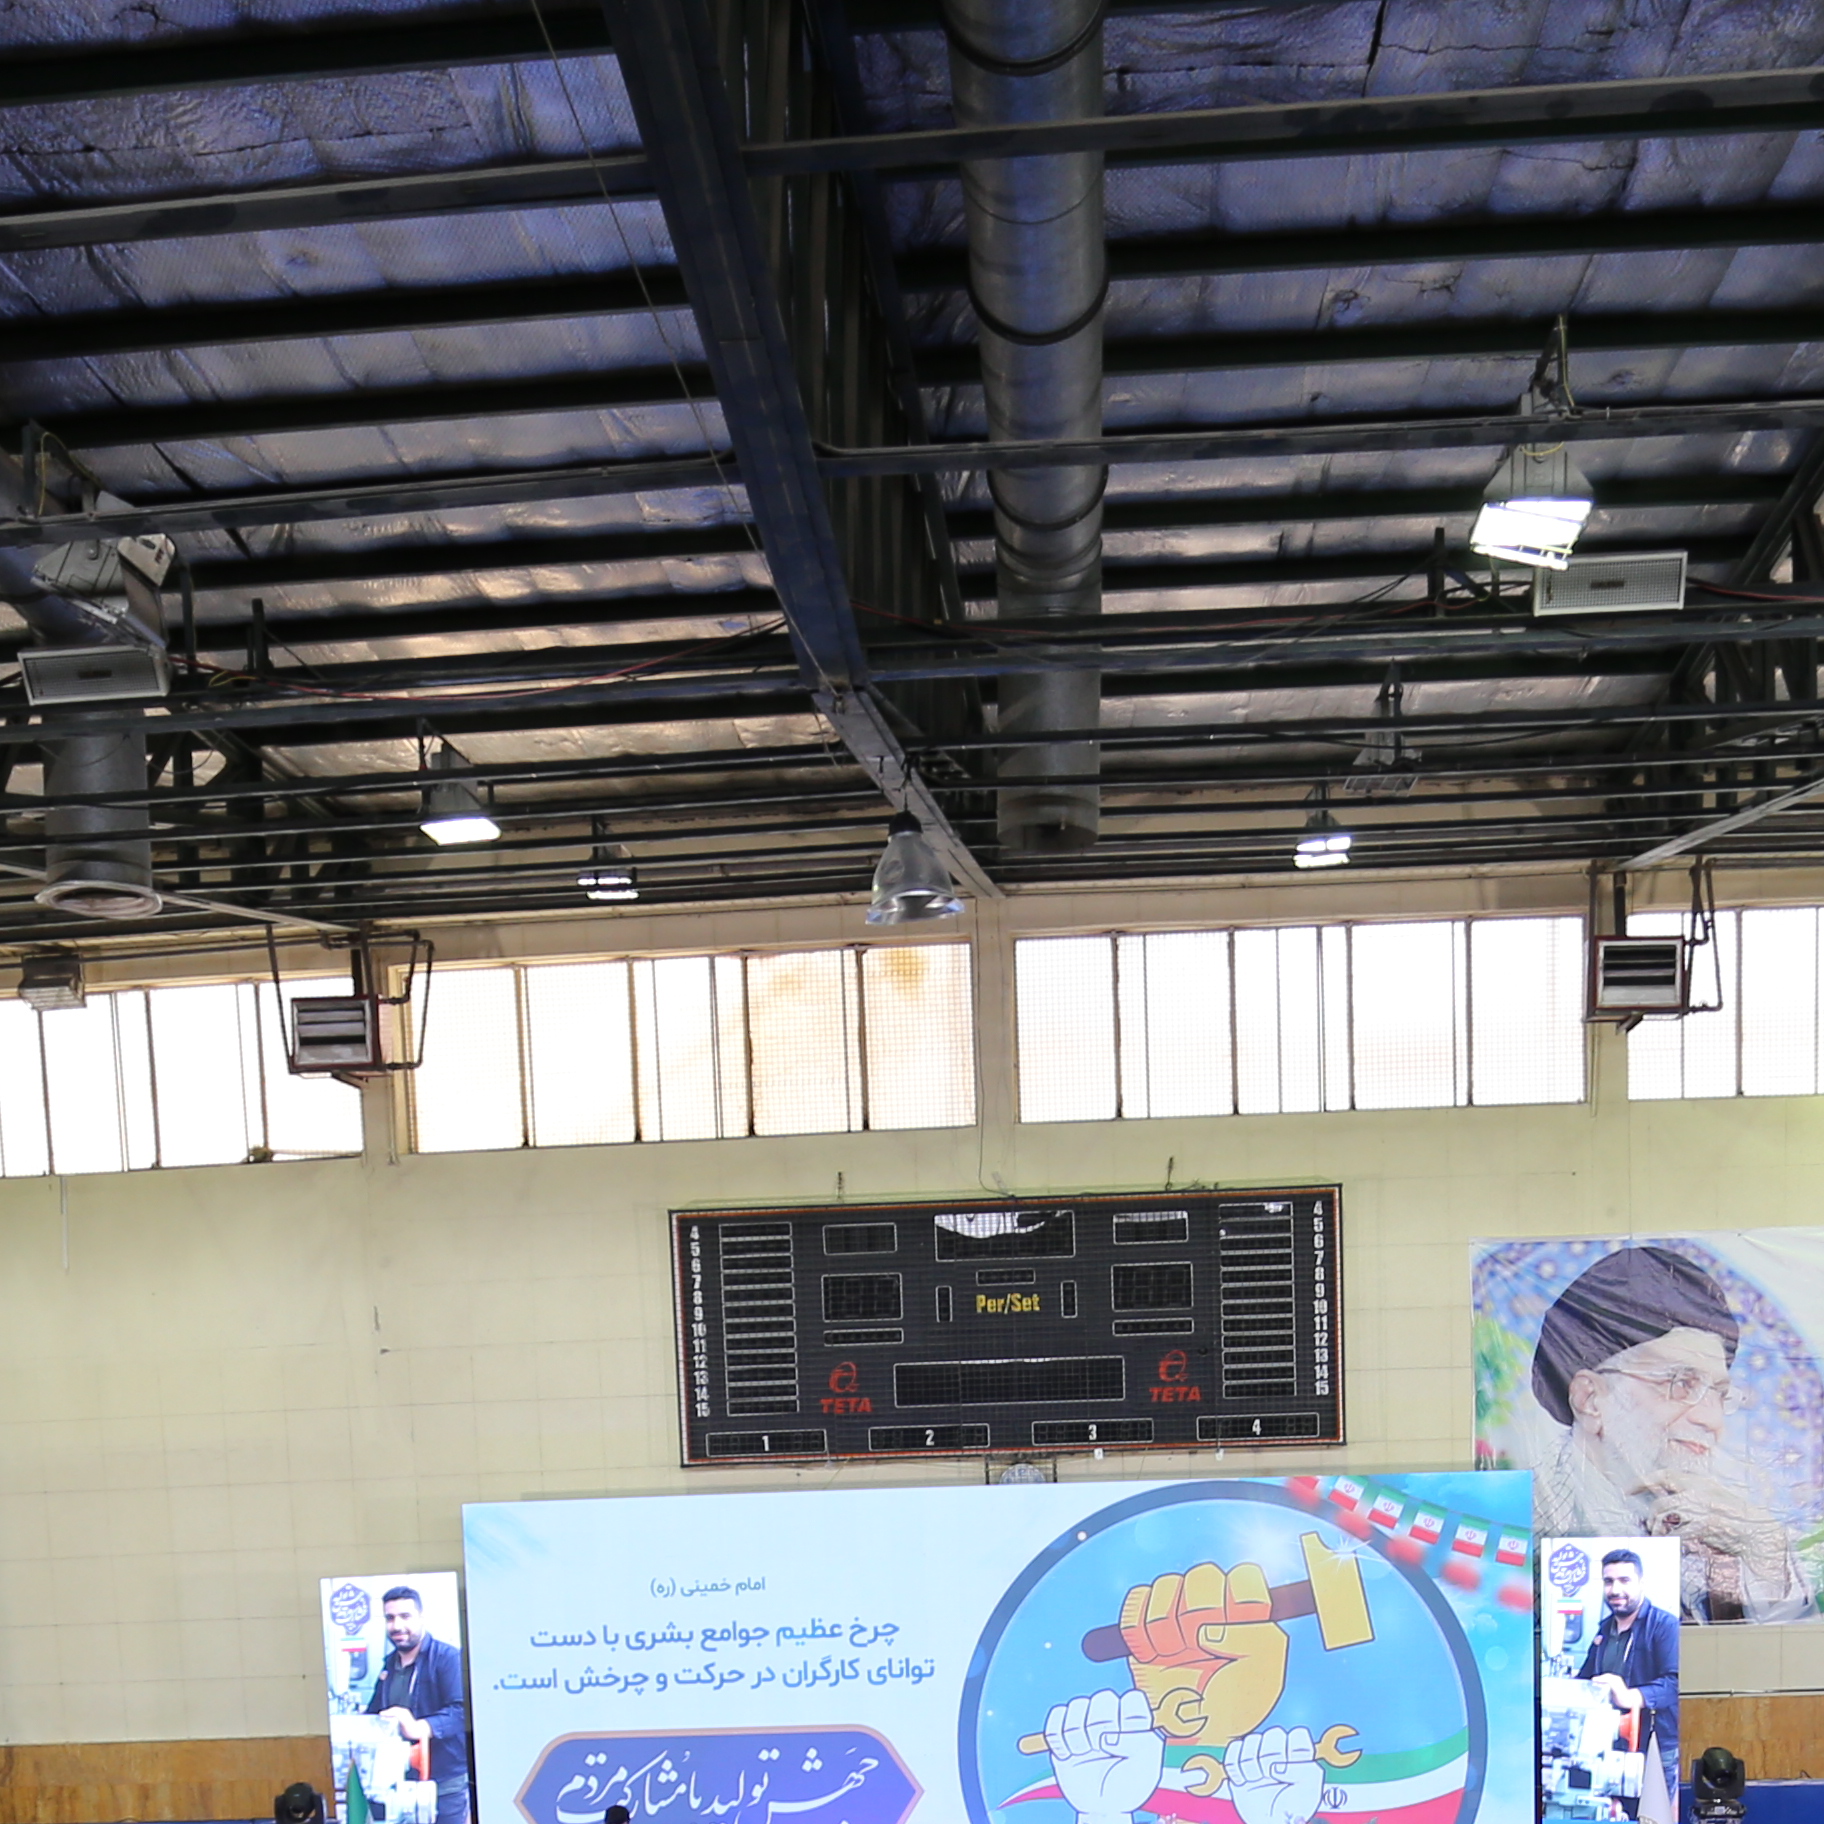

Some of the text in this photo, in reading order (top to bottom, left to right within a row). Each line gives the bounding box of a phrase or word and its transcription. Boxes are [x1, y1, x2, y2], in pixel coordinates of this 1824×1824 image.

[1313, 1200, 1323, 1215] 4
[689, 1225, 699, 1239] 4
[1313, 1217, 1323, 1232] 5
[690, 1242, 701, 1256] 5
[1313, 1234, 1324, 1249] 6
[690, 1258, 701, 1272] 6
[1314, 1250, 1325, 1265] 7
[1314, 1266, 1325, 1282] 8
[691, 1275, 701, 1289] 7
[692, 1291, 703, 1305] 8
[1315, 1283, 1325, 1298] 9
[976, 1293, 1041, 1315] Per/Set
[1312, 1300, 1328, 1315] 10
[693, 1307, 703, 1322] 9
[691, 1323, 707, 1338] 10
[1313, 1316, 1328, 1331] 11
[692, 1339, 707, 1354] 11
[1313, 1332, 1328, 1347] 12
[692, 1355, 708, 1369] 12
[1313, 1348, 1329, 1363] 13
[693, 1370, 709, 1385] 13
[1313, 1364, 1329, 1380] 14
[694, 1386, 710, 1401] 14
[1150, 1386, 1202, 1403] TETA
[1315, 1381, 1330, 1396] 15
[695, 1402, 710, 1417] 15
[821, 1398, 873, 1414] TETA
[1088, 1424, 1097, 1440] 3
[1252, 1419, 1262, 1435] 4
[761, 1435, 770, 1451] 1
[925, 1430, 935, 1446] 2
[680, 1578, 732, 1598] خمینی
[734, 1576, 767, 1597] امام
[529, 1616, 901, 1652] چرخ عظیم جوامع بشری با دست
[673, 1662, 746, 1689] حرکت
[751, 1665, 776, 1689] در
[782, 1654, 861, 1688] کارگران
[866, 1657, 936, 1686] توانای
[563, 1664, 651, 1696] چرخش
[656, 1671, 668, 1691] و
[558, 1765, 629, 1805] مردم
